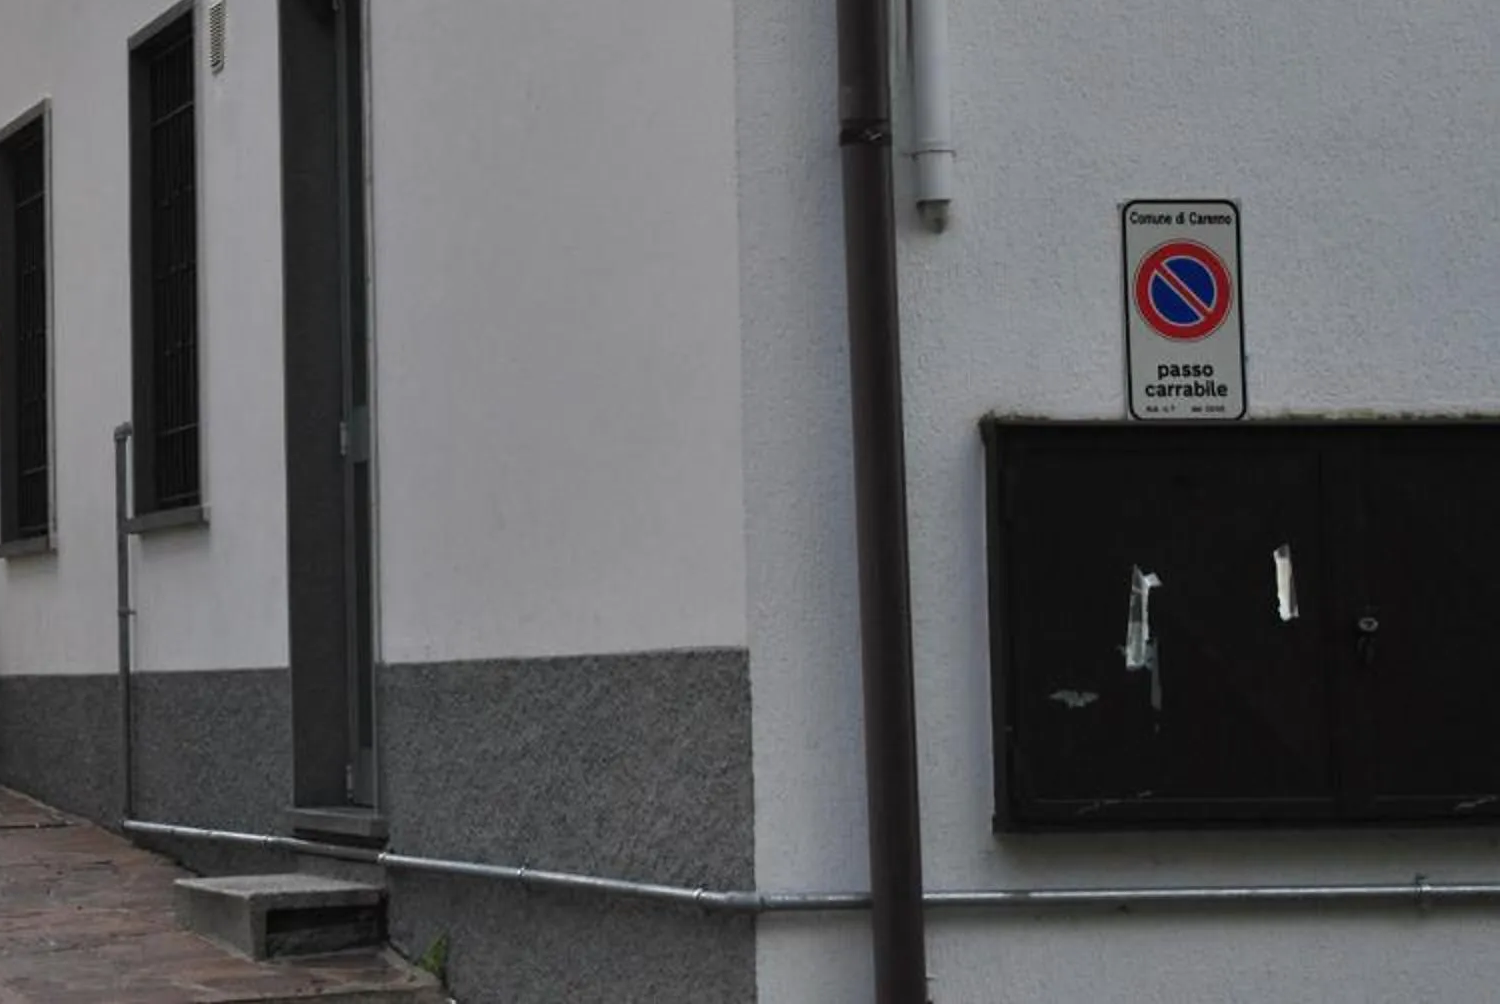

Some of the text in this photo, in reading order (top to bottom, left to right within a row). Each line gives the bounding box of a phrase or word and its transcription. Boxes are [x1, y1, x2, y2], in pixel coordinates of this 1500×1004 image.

[1129, 211, 1173, 225] Comune
[1157, 363, 1214, 380] passo
[1145, 379, 1229, 397] carrabile
